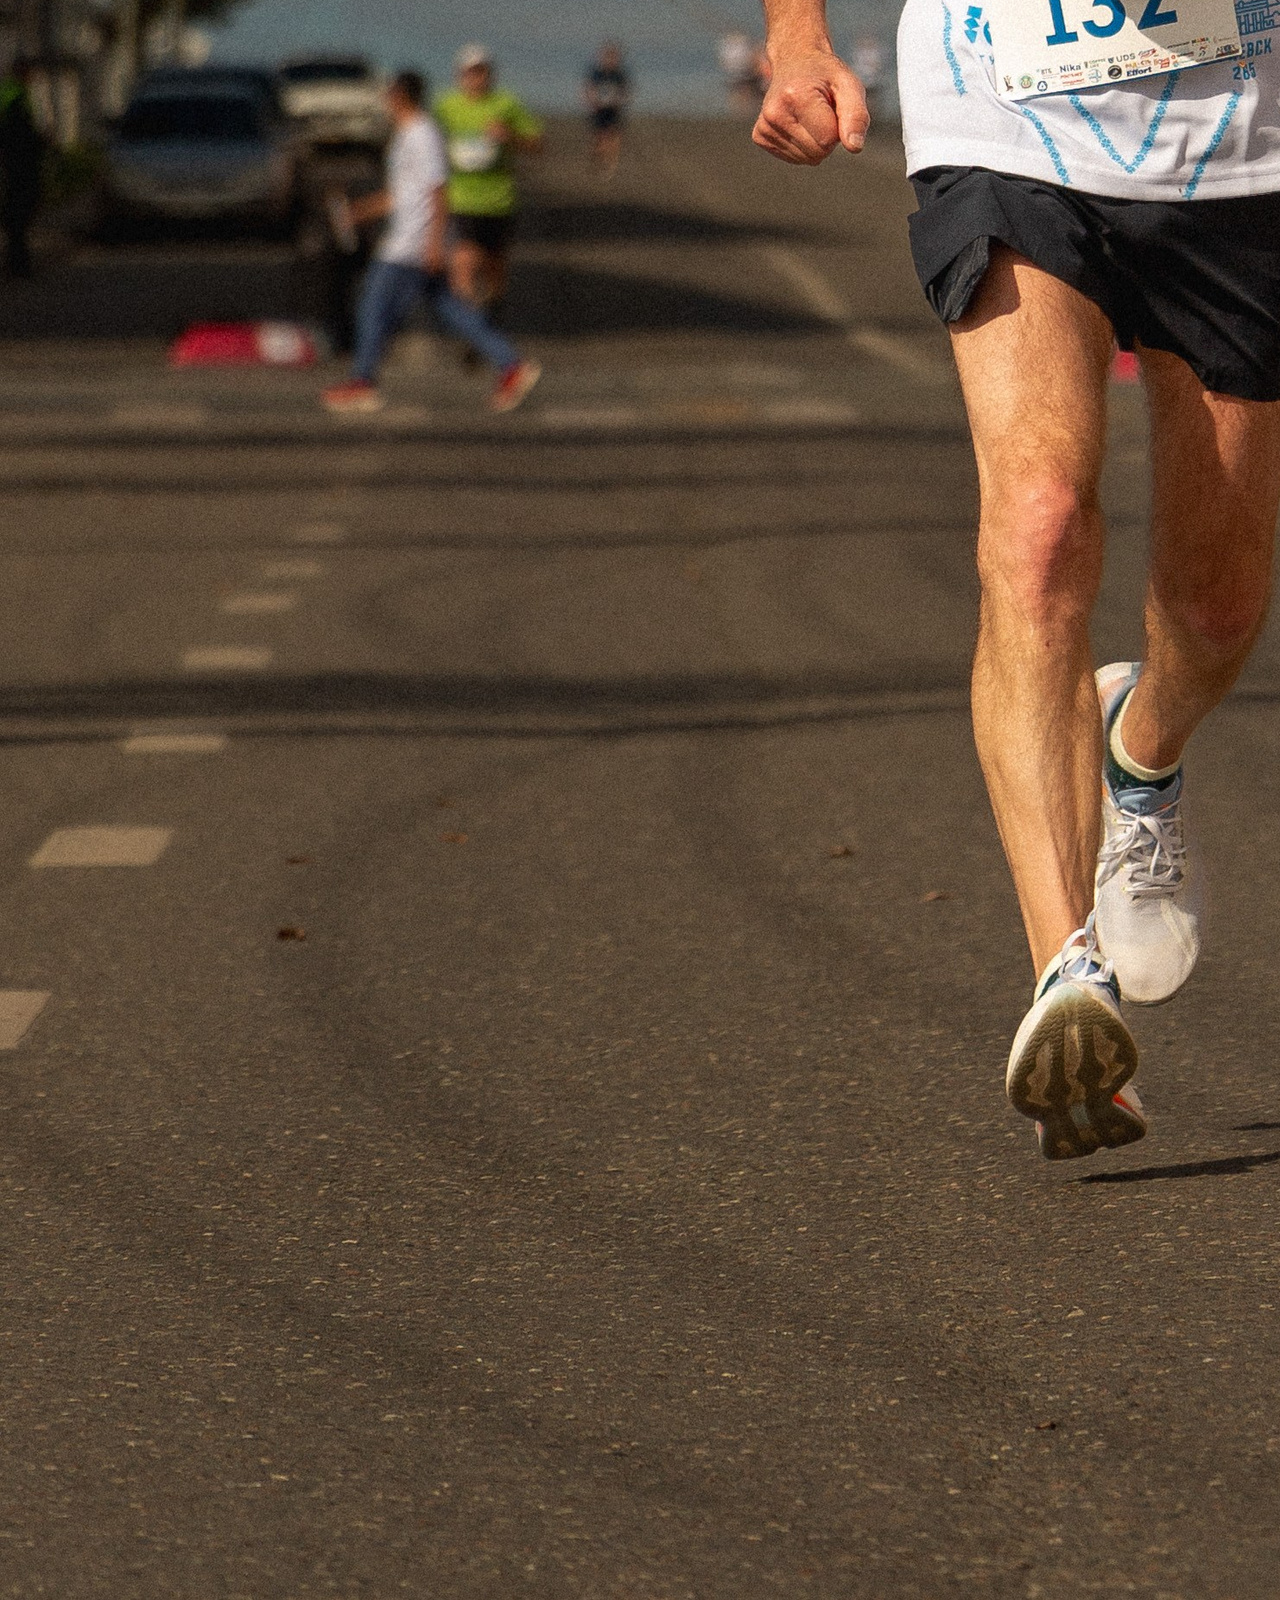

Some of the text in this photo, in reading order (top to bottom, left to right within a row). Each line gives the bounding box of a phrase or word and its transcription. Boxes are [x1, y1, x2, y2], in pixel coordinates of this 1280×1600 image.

[1116, 53, 1136, 63] UDS
[1059, 64, 1081, 73] Nika
[1126, 67, 1152, 77] Effort
